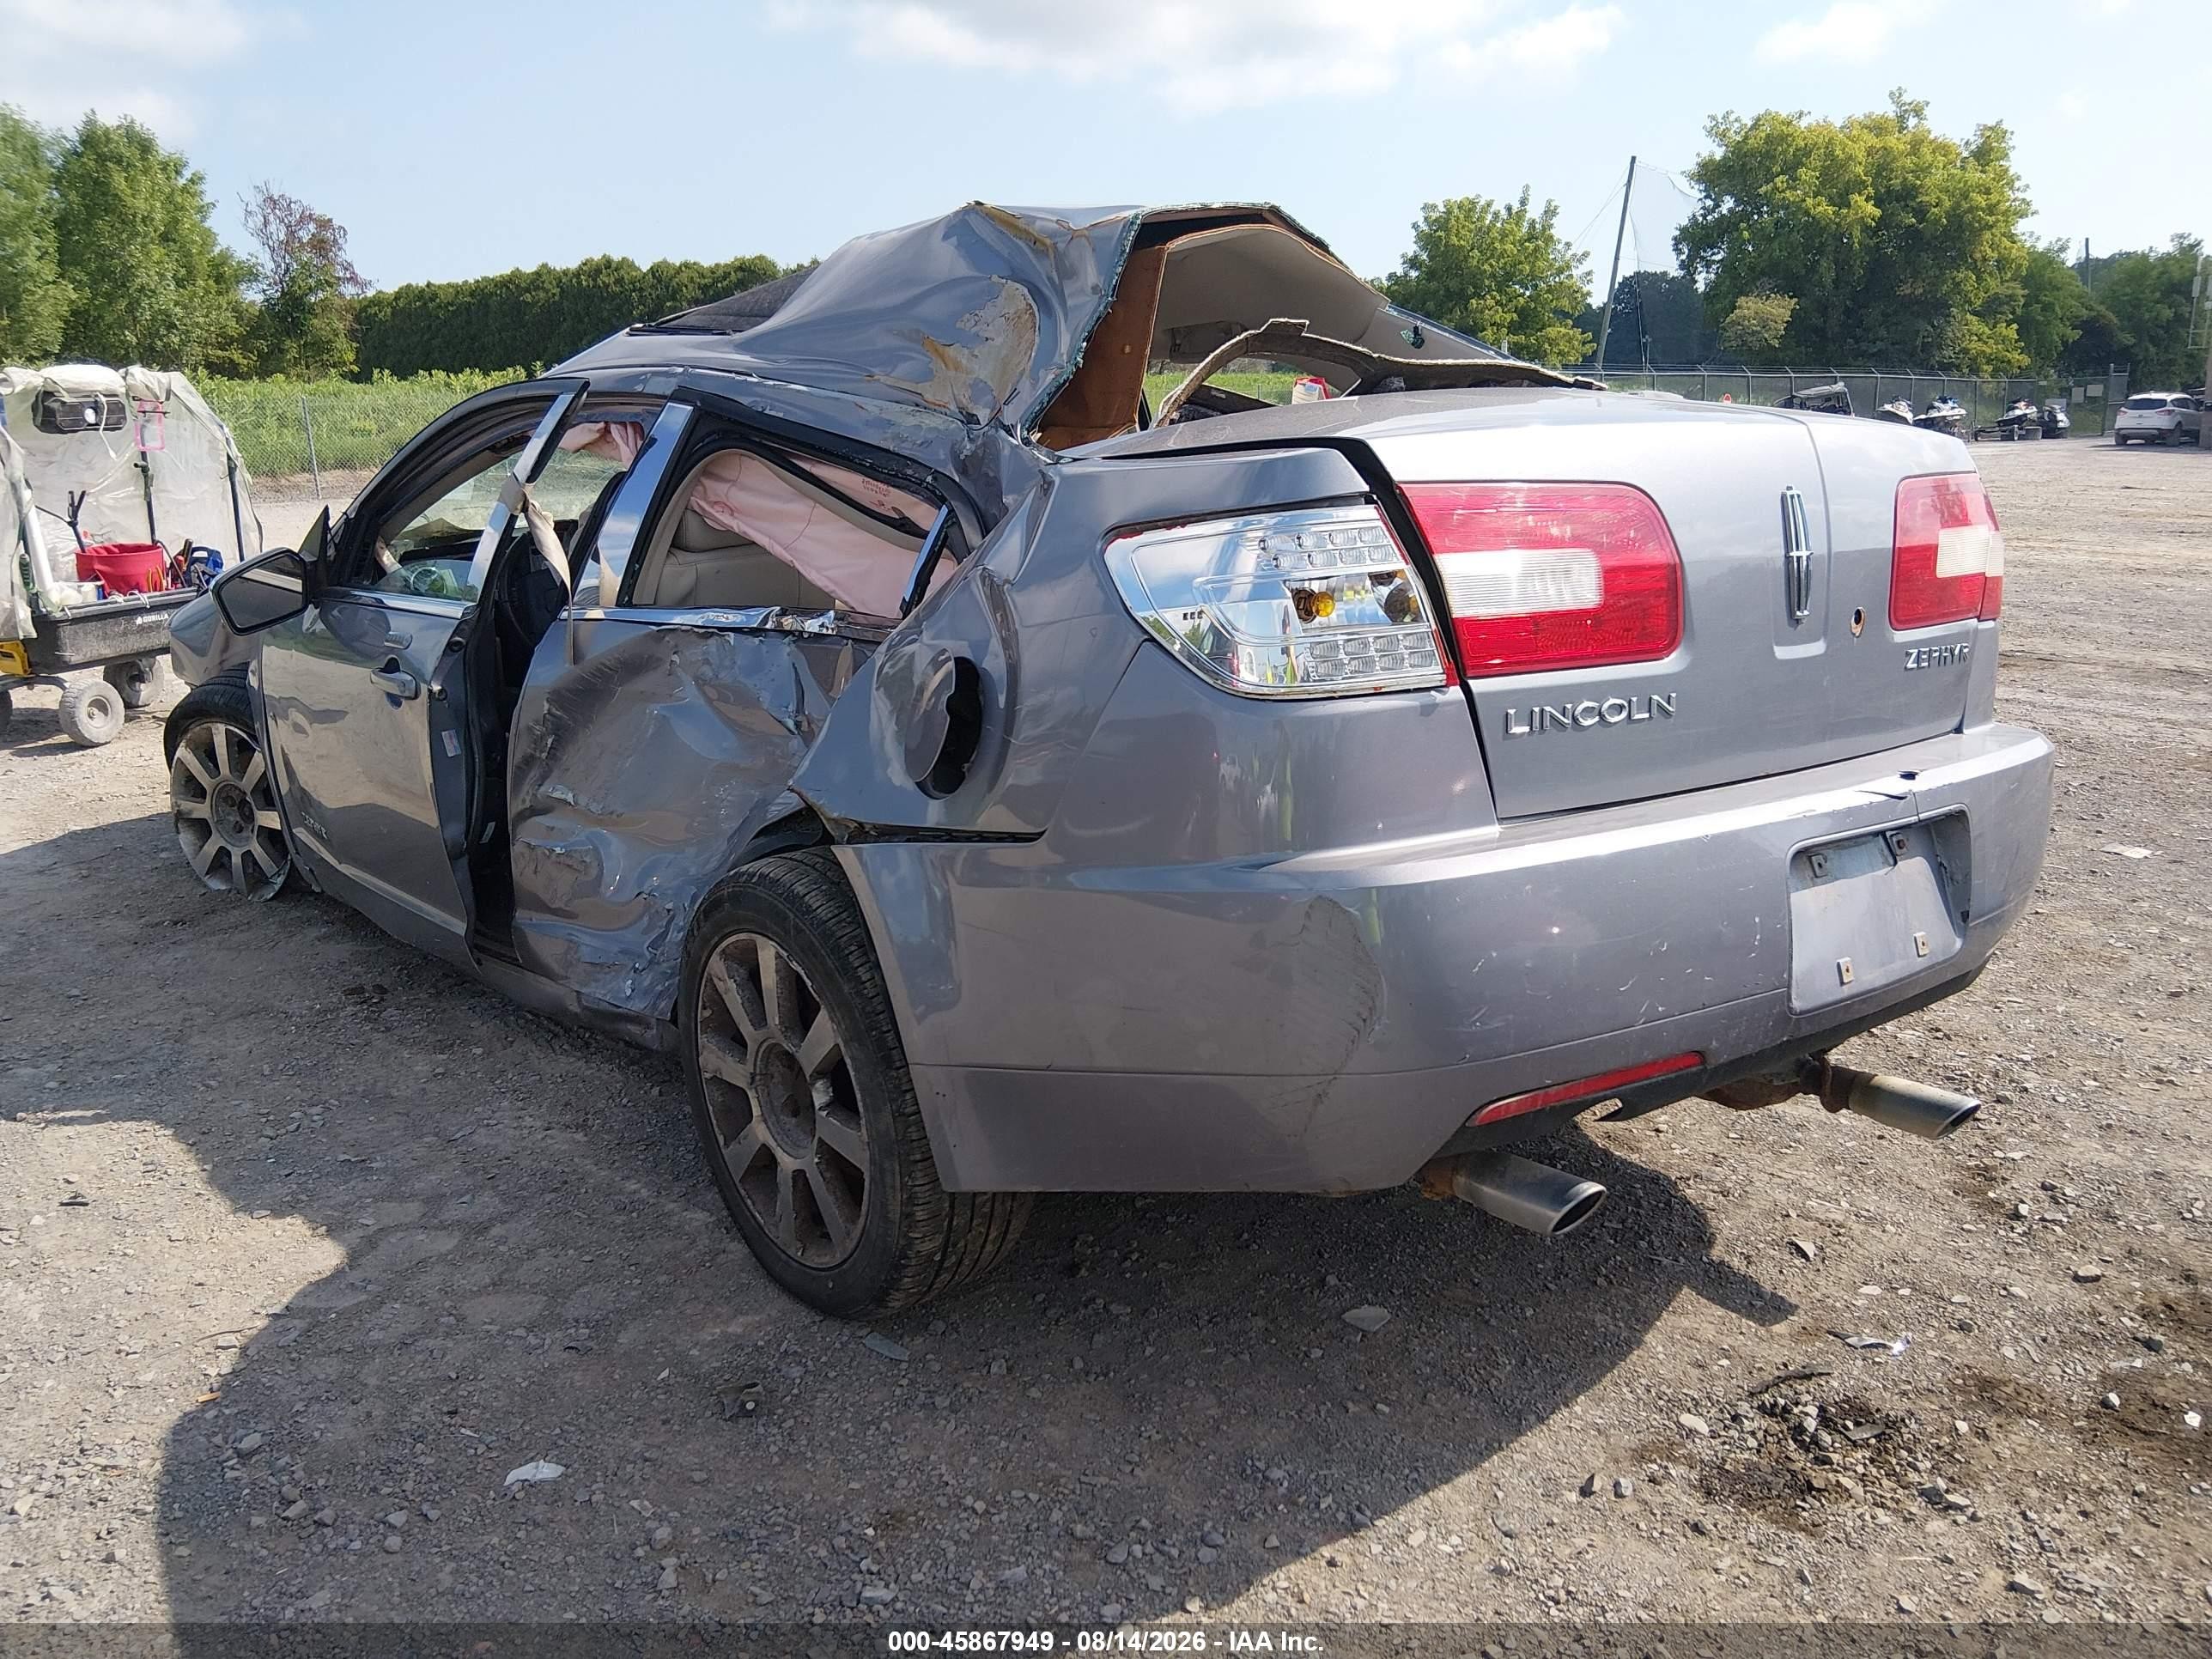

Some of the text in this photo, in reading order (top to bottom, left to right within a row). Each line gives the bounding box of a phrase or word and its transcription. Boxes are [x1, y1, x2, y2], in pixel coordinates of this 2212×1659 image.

[143, 612, 169, 623] GORILLA
[1905, 643, 1970, 670] ZEPHYR
[1506, 692, 1676, 734] LINCOLN
